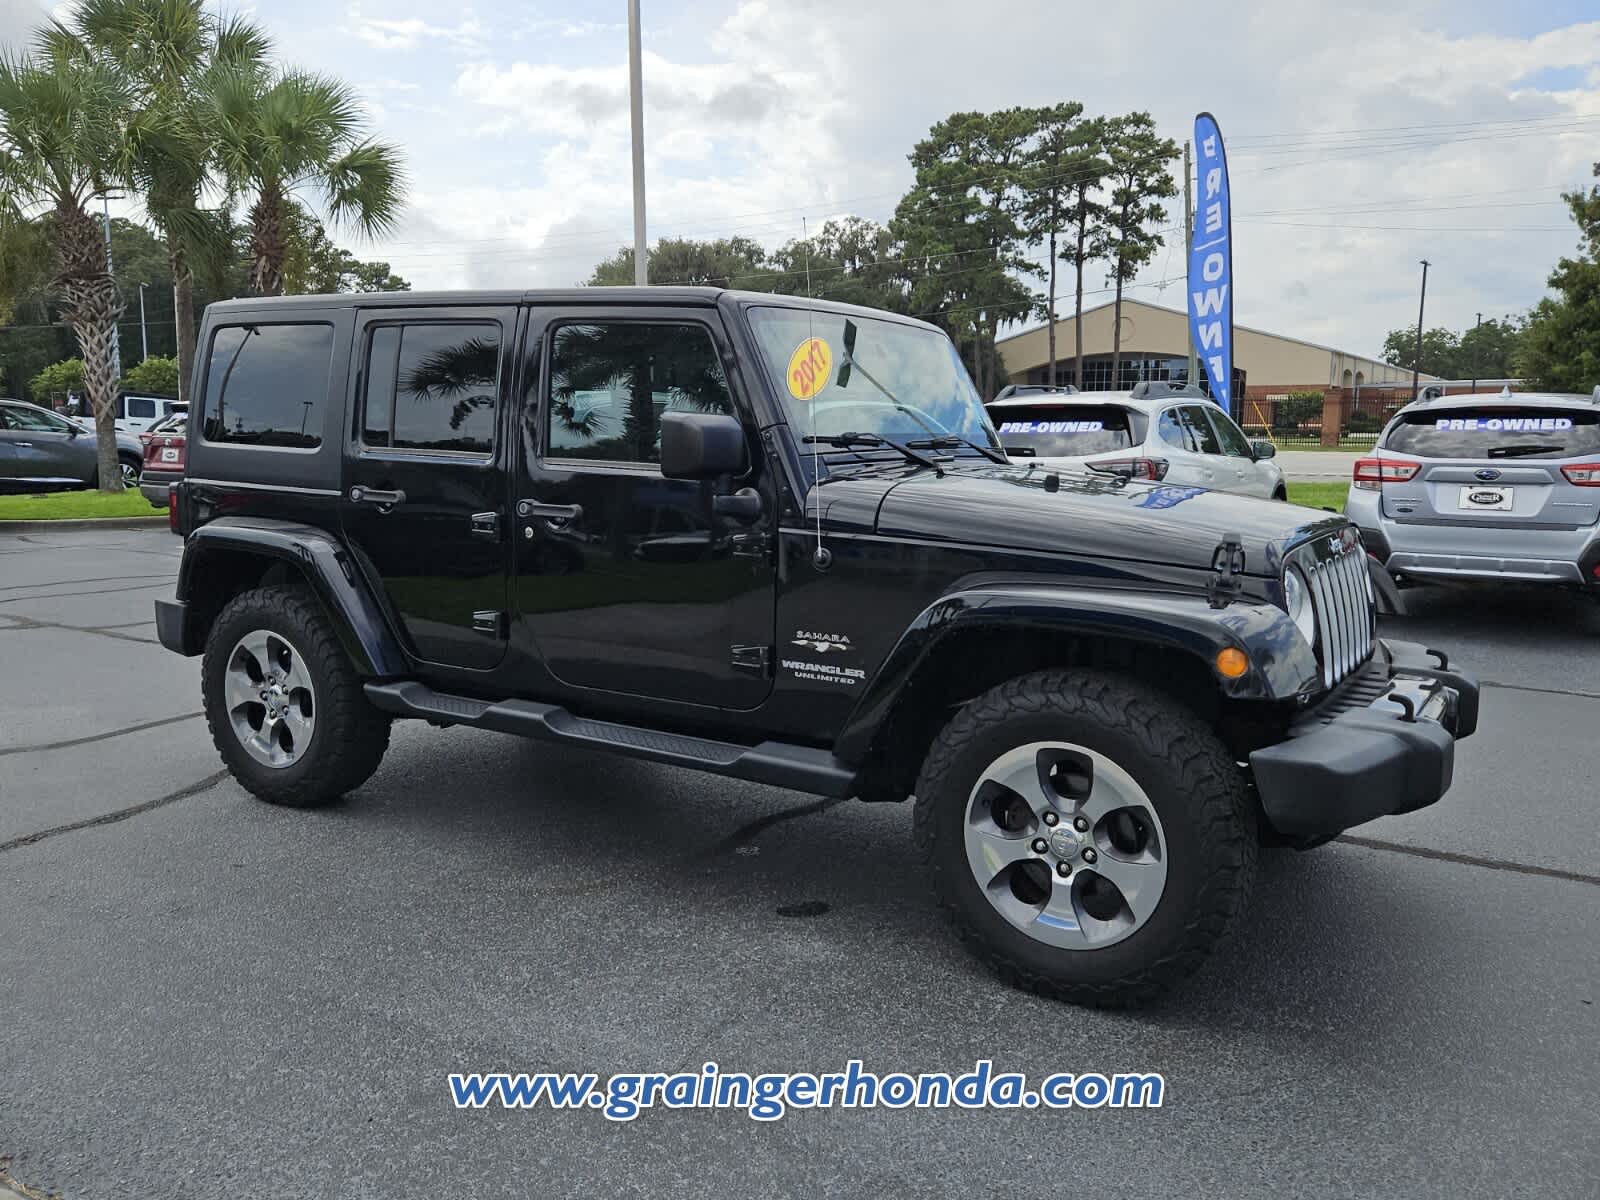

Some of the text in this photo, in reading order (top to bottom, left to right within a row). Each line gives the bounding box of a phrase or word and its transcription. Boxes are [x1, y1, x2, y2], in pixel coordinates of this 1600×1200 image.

[793, 341, 826, 395] 2017
[999, 421, 1104, 433] PRE-OWNED
[1435, 418, 1572, 431] PRE-OWNED
[796, 630, 851, 644] SAHARA
[782, 659, 866, 679] WRANGLER
[794, 671, 855, 685] UNLIMITED
